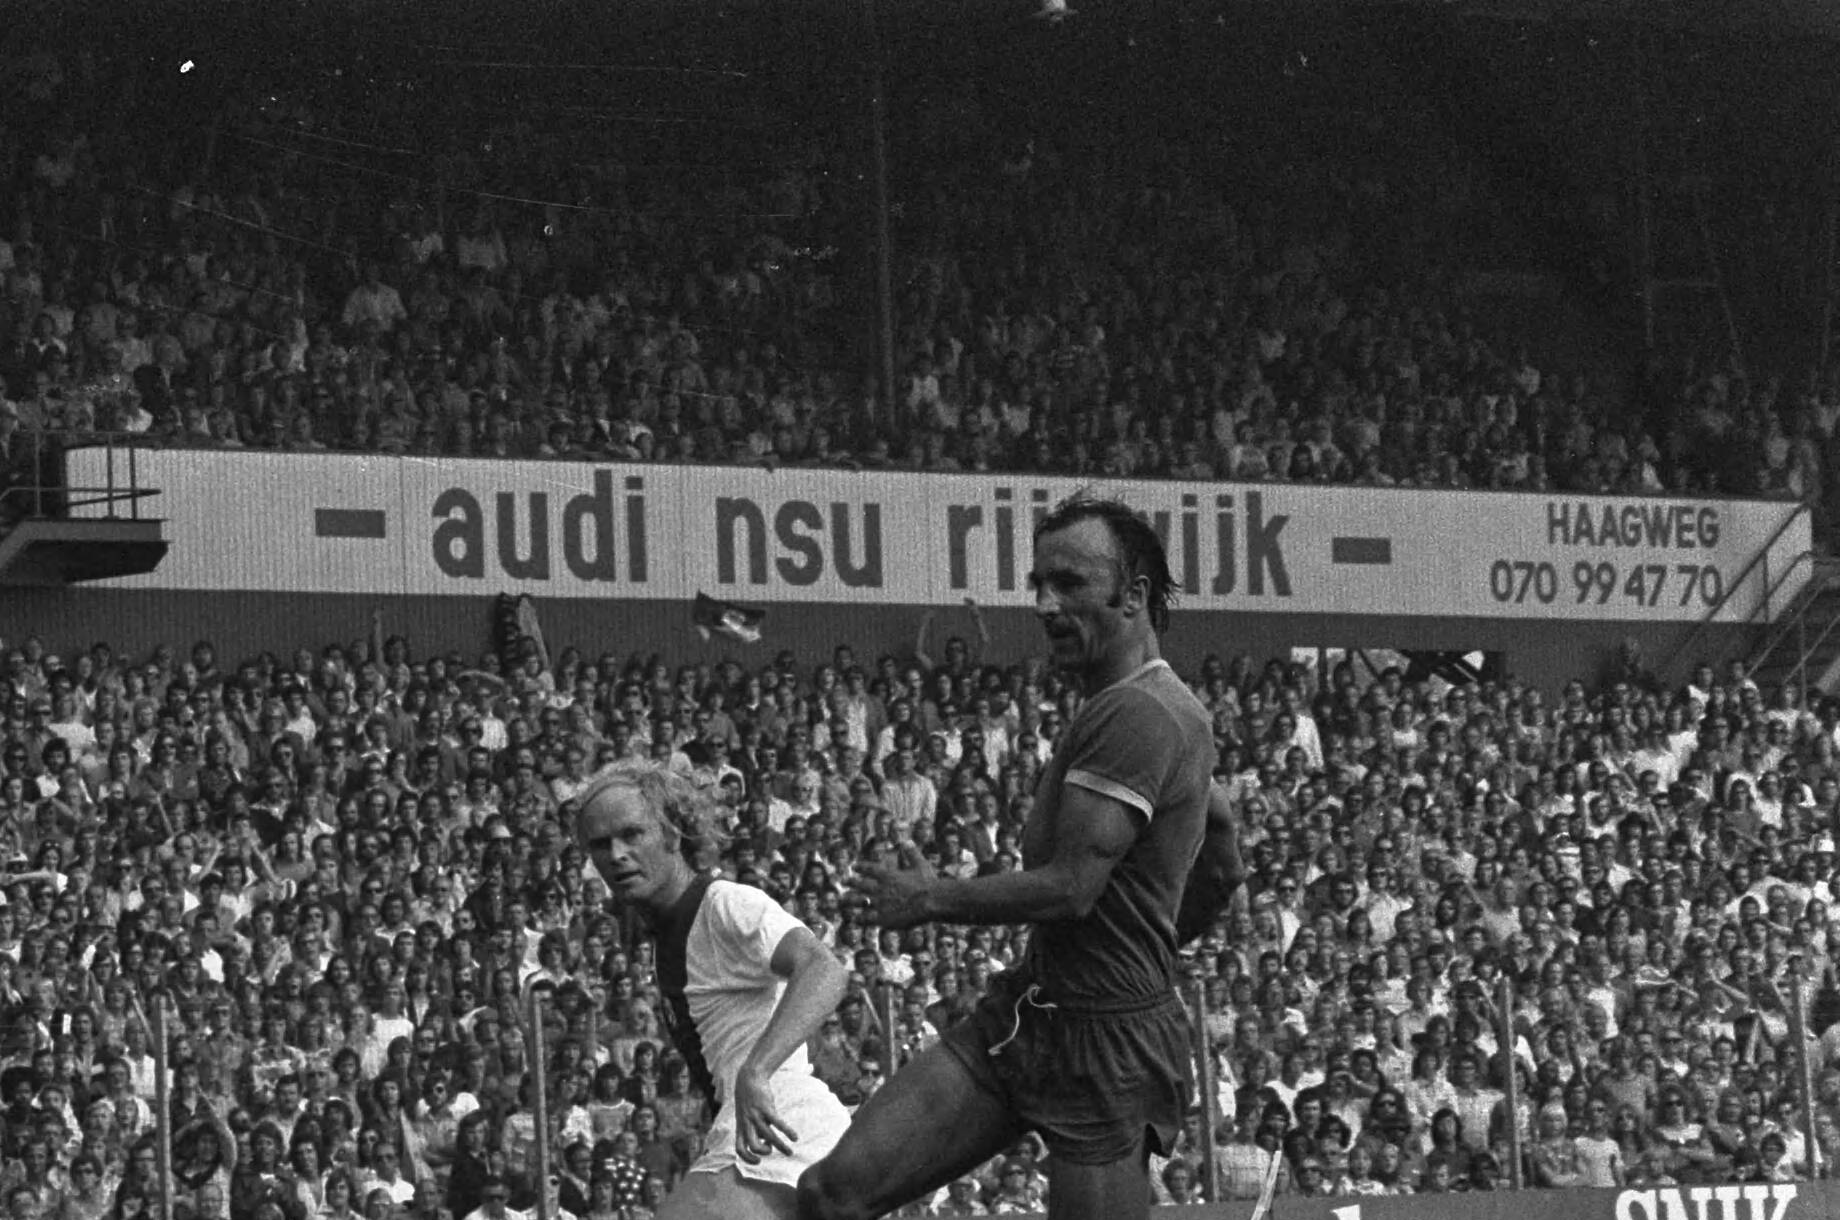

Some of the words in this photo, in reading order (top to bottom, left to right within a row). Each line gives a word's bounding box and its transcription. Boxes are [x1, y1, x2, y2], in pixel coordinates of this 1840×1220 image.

[432, 469, 648, 583] audi
[716, 496, 884, 588] nsu
[947, 487, 1292, 596] riijk
[1547, 502, 1721, 549] HAAGWEG
[1490, 559, 1558, 605] 070
[1573, 560, 1617, 605] 99
[1624, 563, 1667, 607] 47
[1676, 564, 1722, 608] 70
